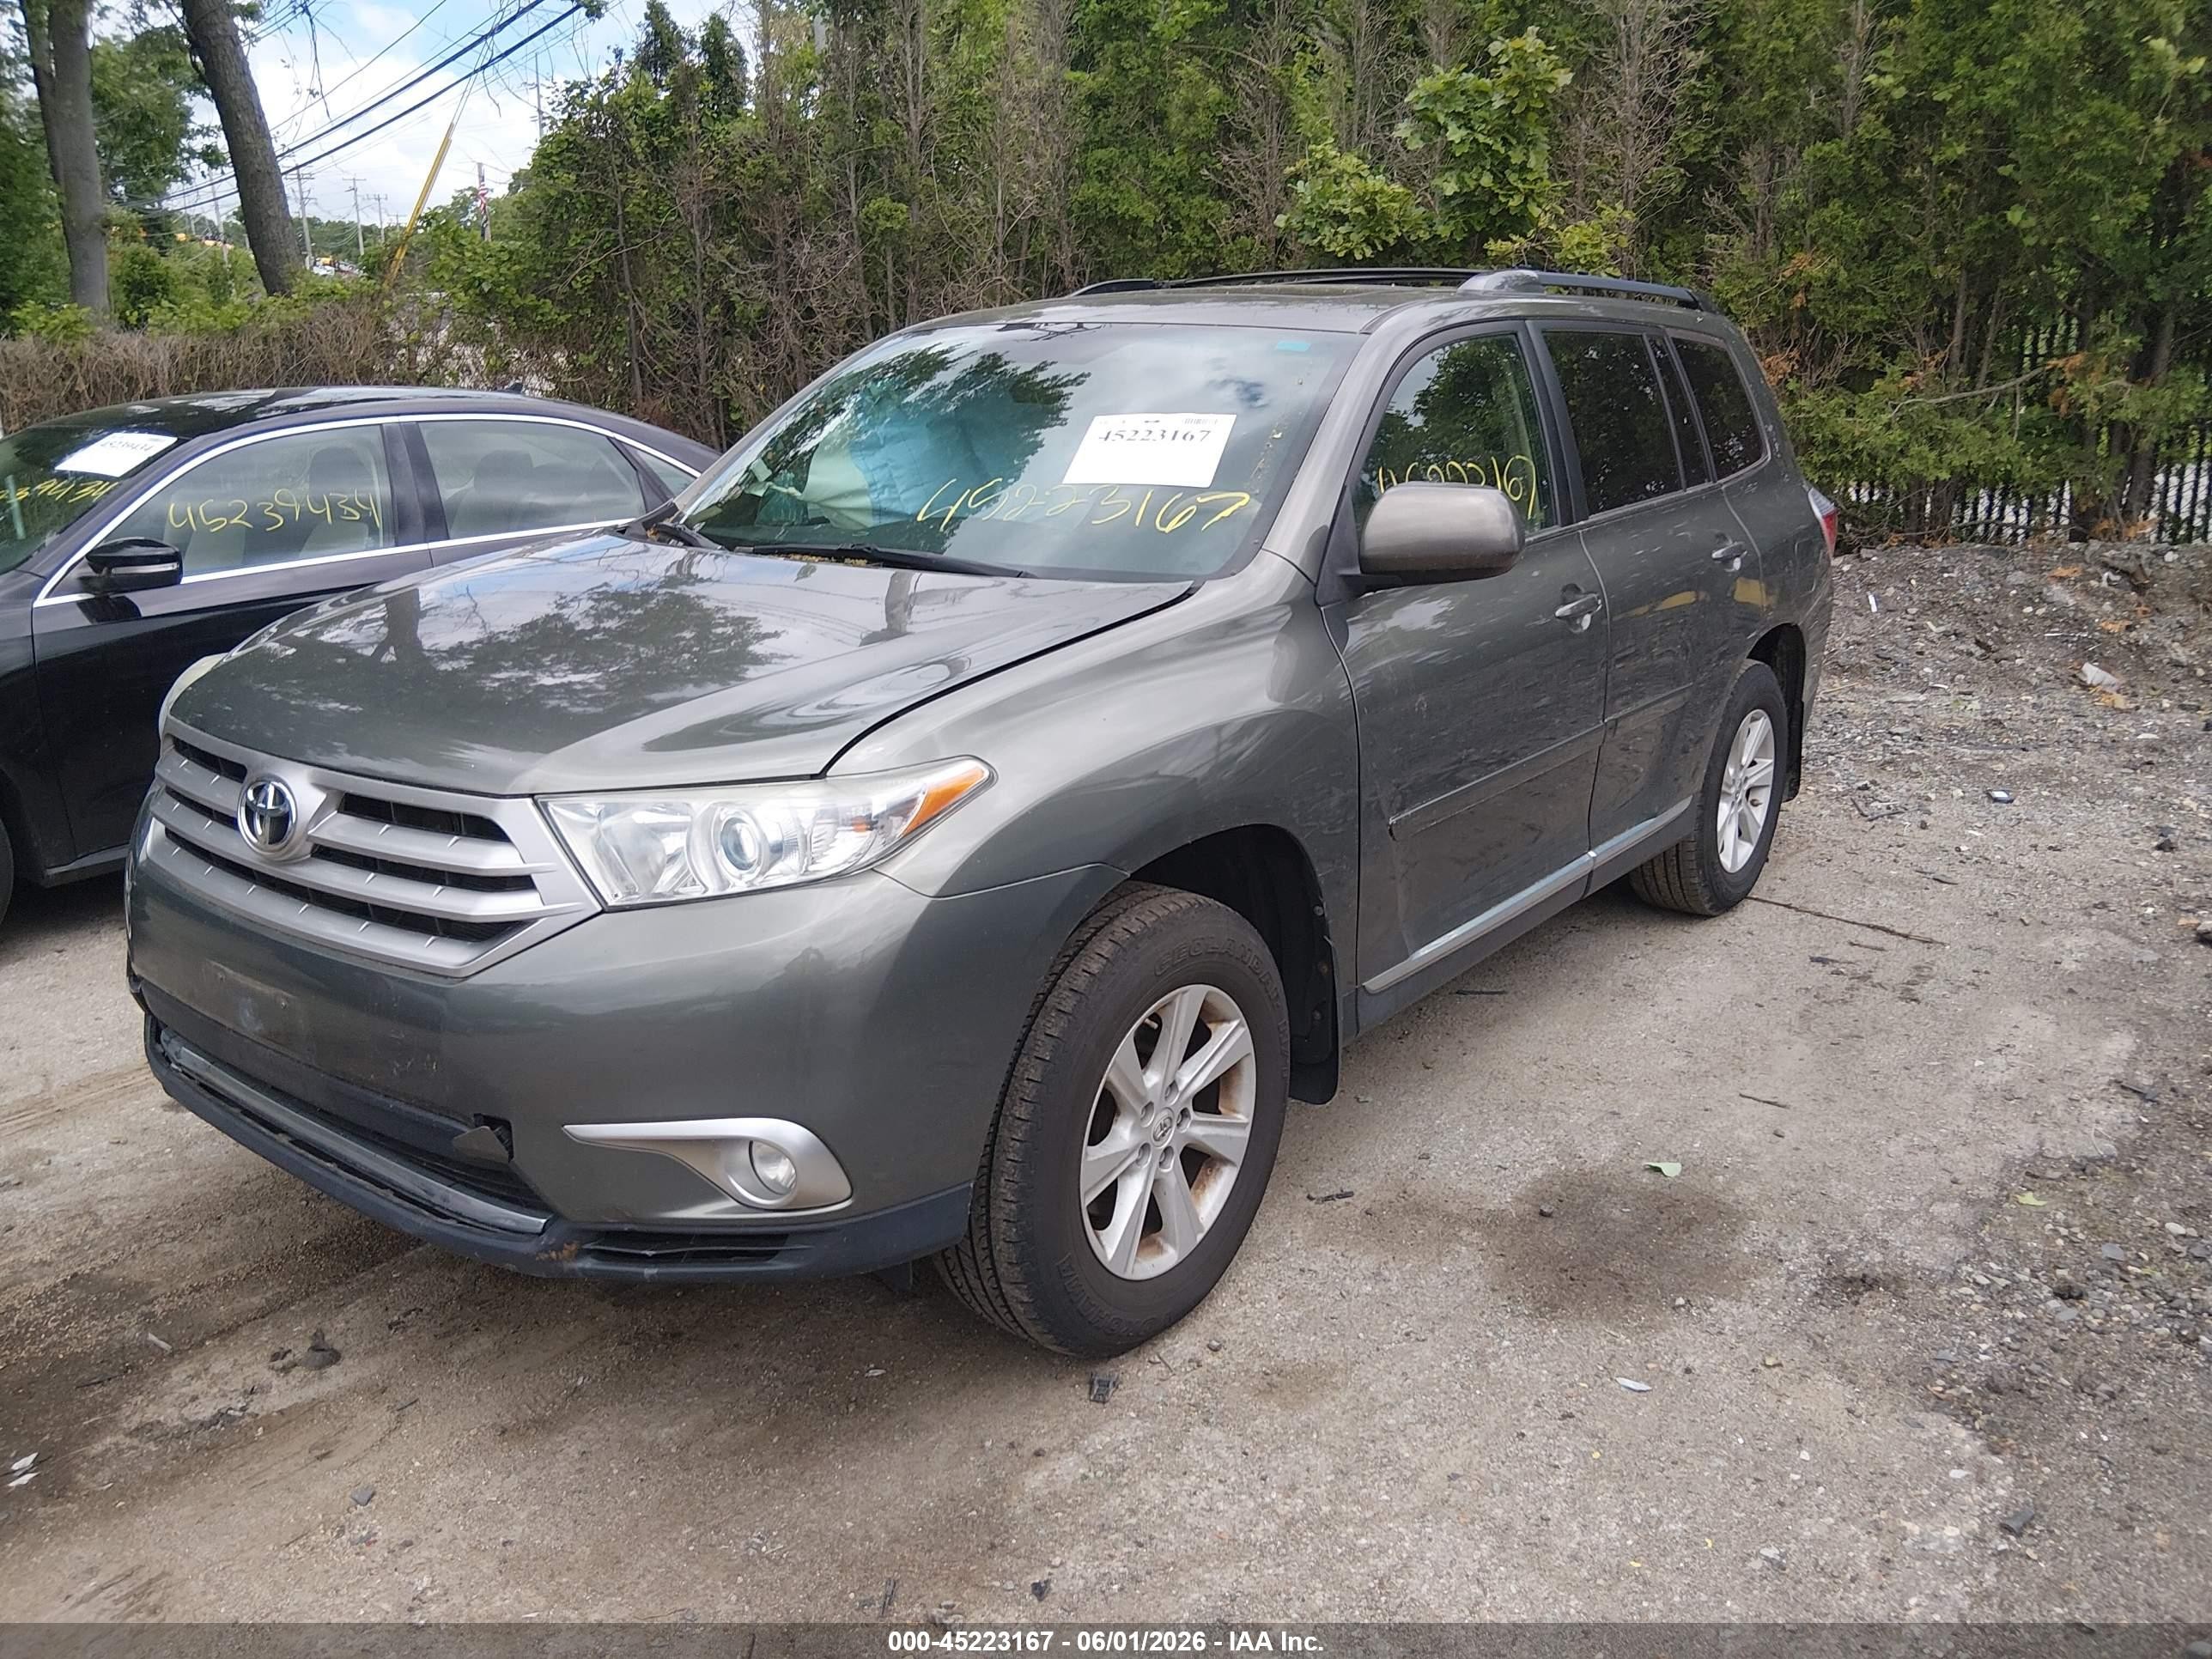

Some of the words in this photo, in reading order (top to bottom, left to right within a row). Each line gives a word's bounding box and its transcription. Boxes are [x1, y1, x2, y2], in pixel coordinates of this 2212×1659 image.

[1098, 428, 1212, 442] 45223167
[169, 488, 382, 532] 45239434
[915, 477, 1251, 534] 45223167
